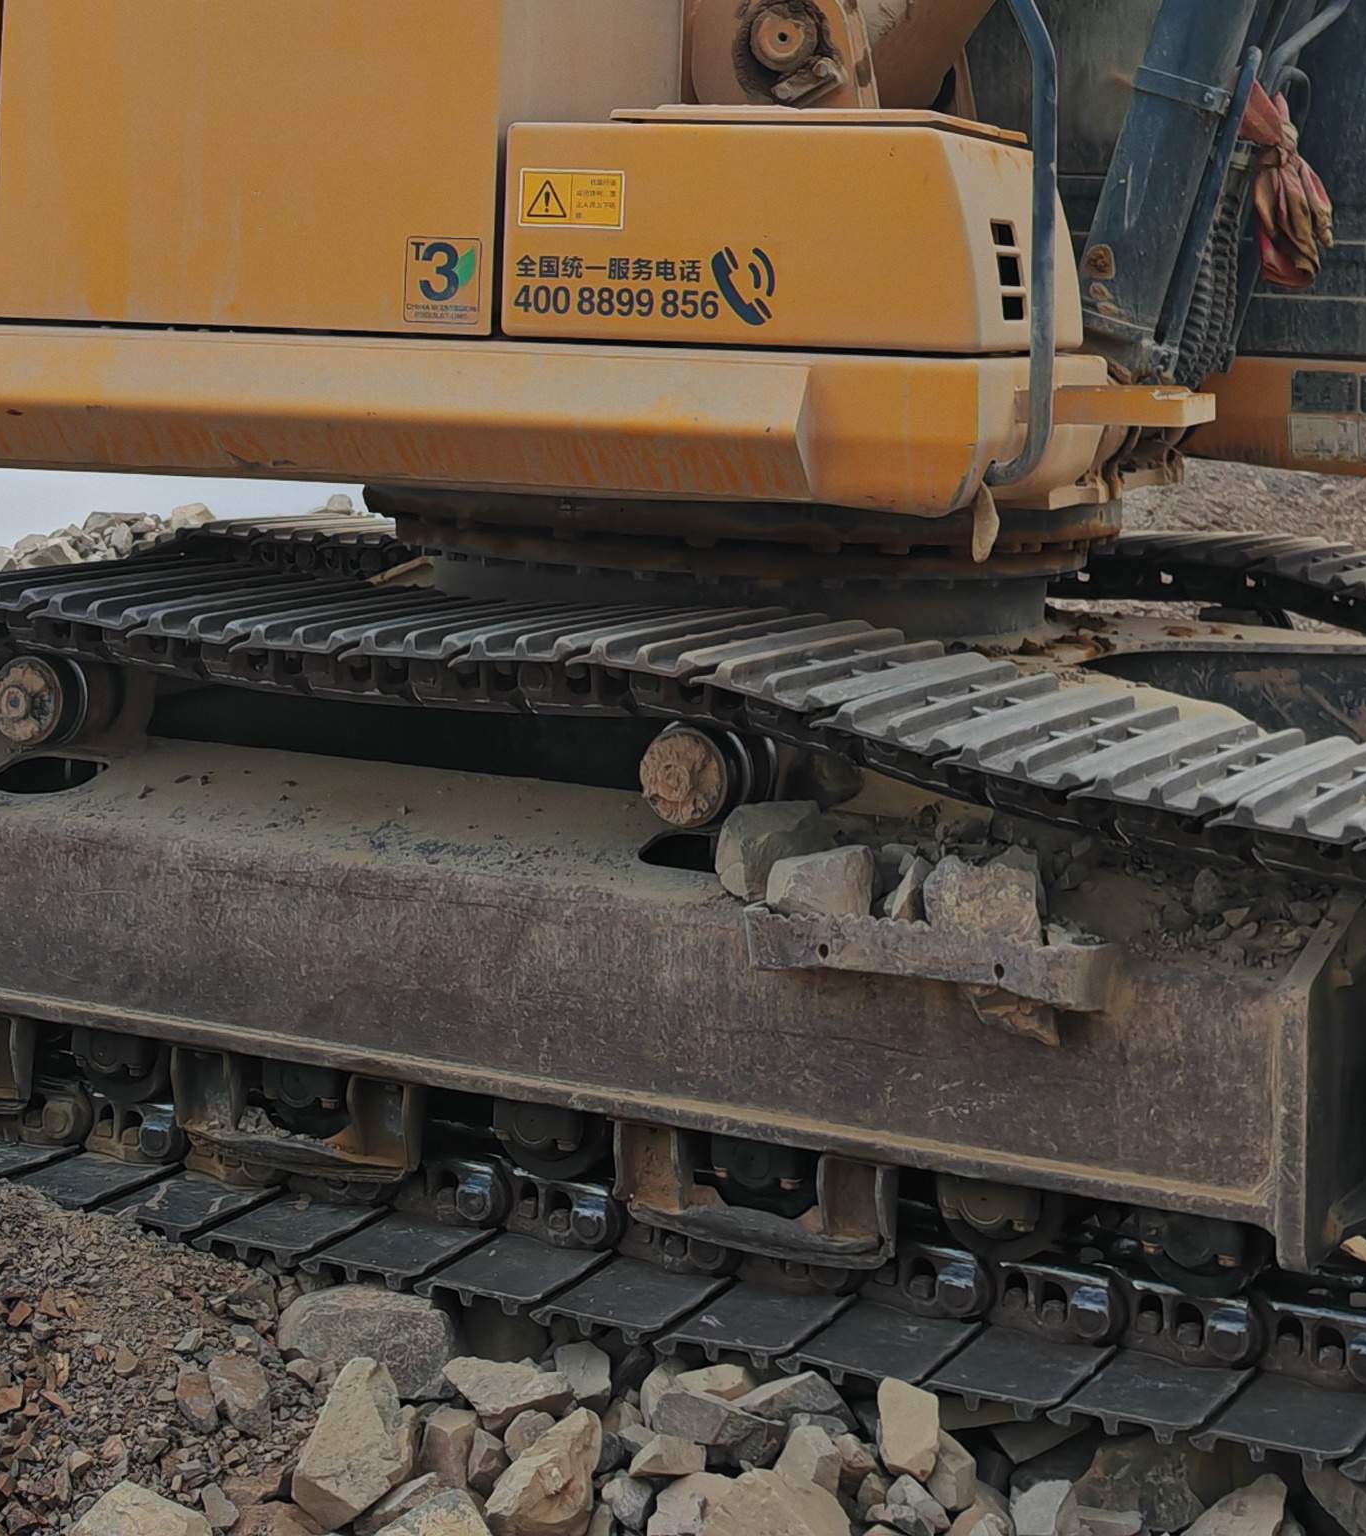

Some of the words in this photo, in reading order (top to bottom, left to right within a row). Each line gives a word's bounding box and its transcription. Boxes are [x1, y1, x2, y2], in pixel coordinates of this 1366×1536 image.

[515, 255, 702, 283] 全国统一服务电话
[514, 284, 571, 314] 400
[577, 286, 655, 318] 8899
[660, 288, 719, 319] 856
